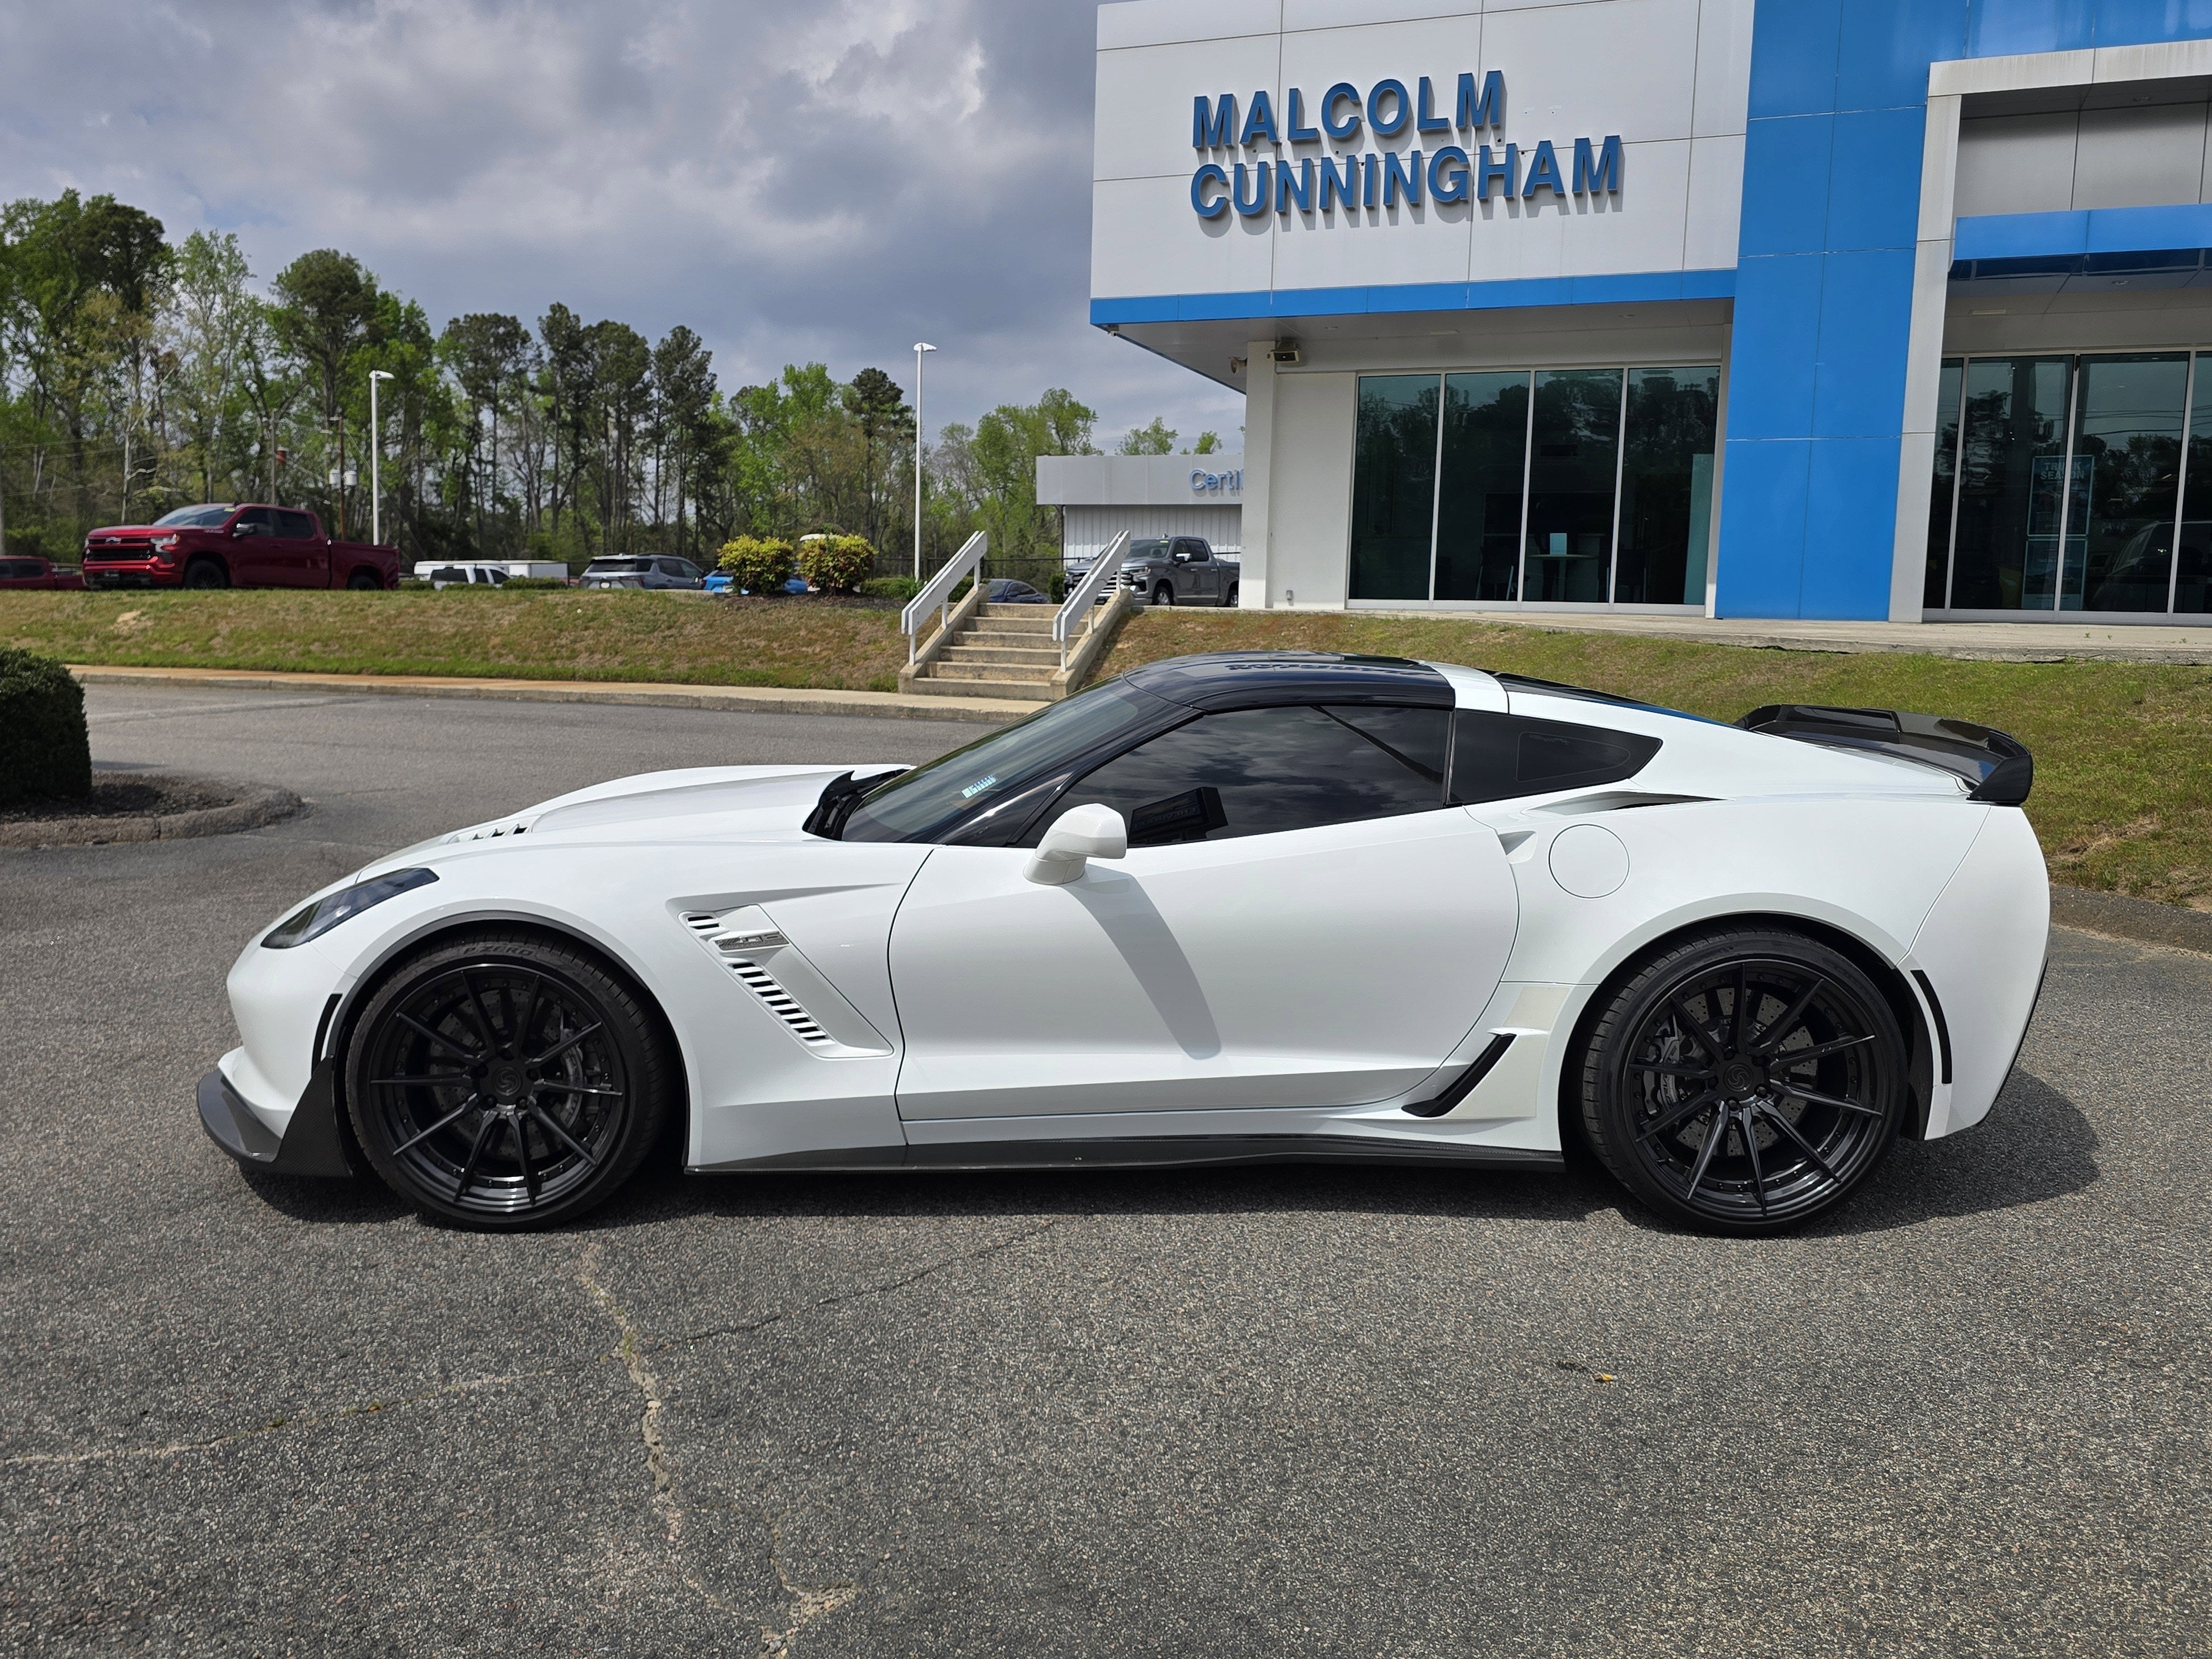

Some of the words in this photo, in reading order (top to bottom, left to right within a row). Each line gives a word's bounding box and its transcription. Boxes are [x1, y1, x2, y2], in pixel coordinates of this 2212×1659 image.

[1192, 70, 1506, 149] MALCOLM
[1191, 135, 1621, 218] CUNNINGHAM
[2044, 461, 2081, 471] TRUK
[2040, 470, 2084, 479] SEAON
[479, 946, 534, 956] ZERO
